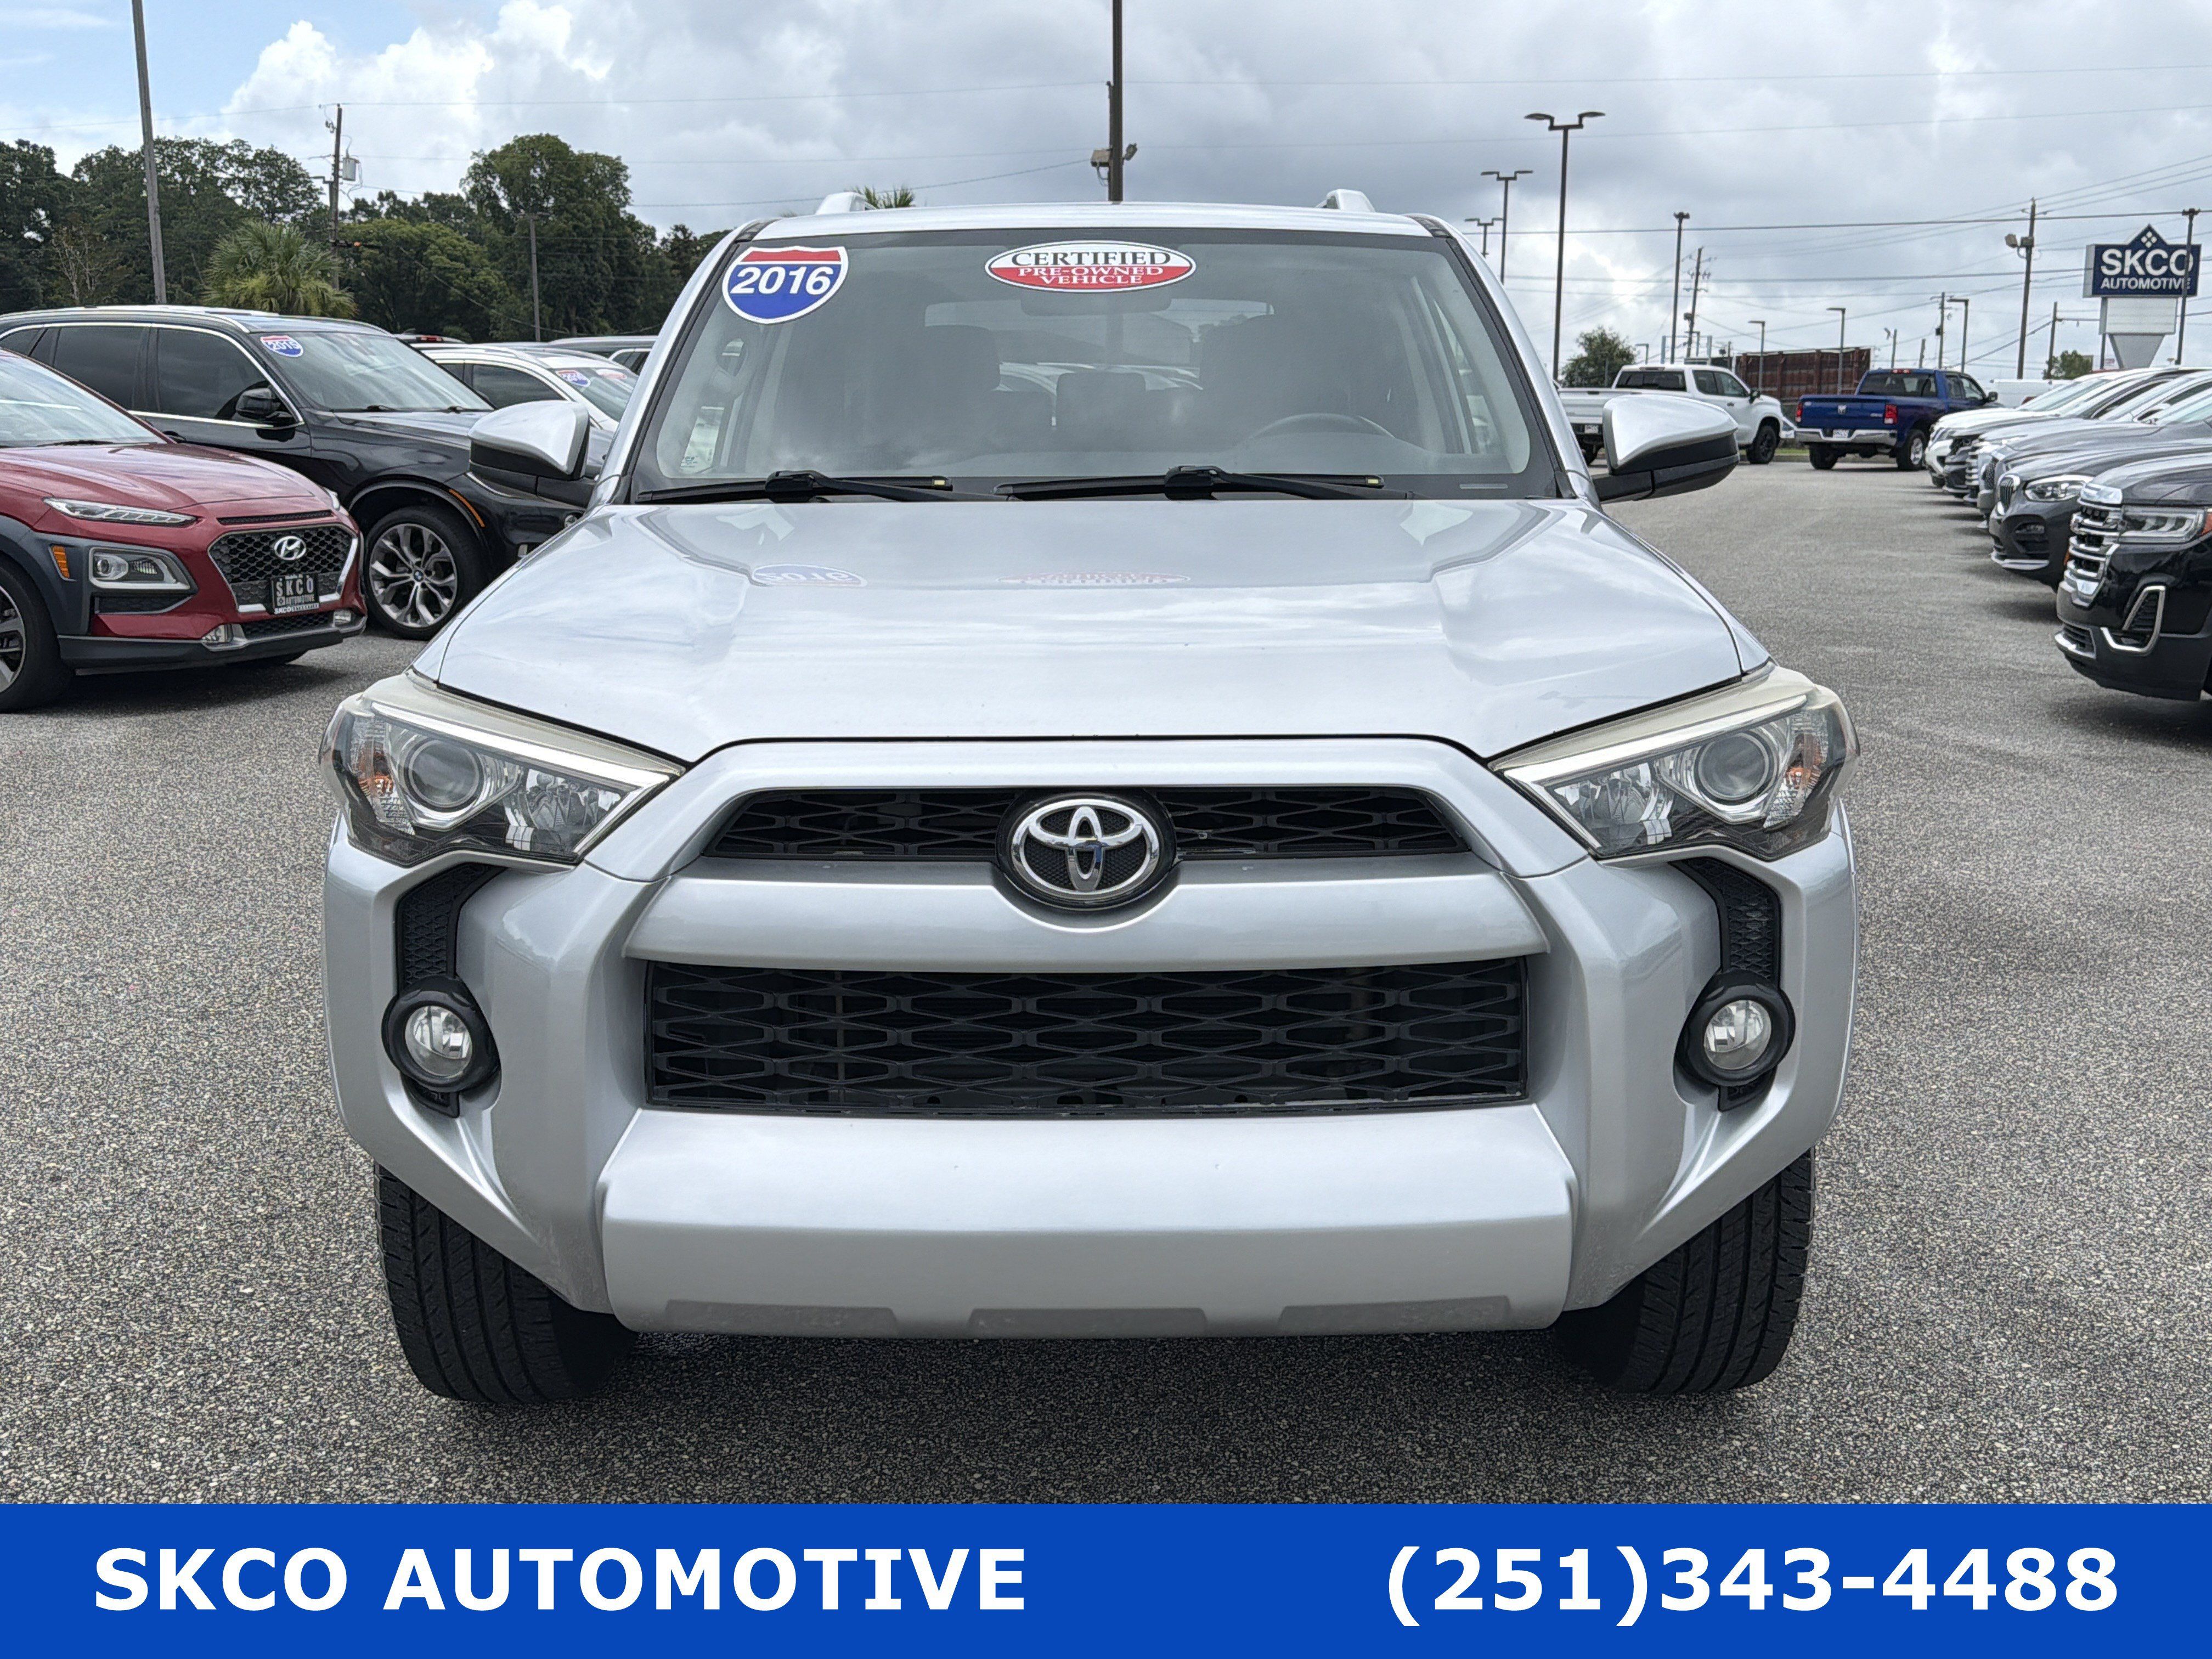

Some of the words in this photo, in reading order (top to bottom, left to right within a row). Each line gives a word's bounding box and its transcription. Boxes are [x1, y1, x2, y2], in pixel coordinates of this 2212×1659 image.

[1012, 252, 1171, 266] CERTIFIED
[2101, 249, 2193, 276] SKCO
[1018, 267, 1163, 276] PRE-OWNED
[730, 266, 834, 295] 2016
[1040, 276, 1143, 285] VEHICLE
[2101, 277, 2191, 290] AUTOMOTIVE
[276, 577, 314, 597] SKCO
